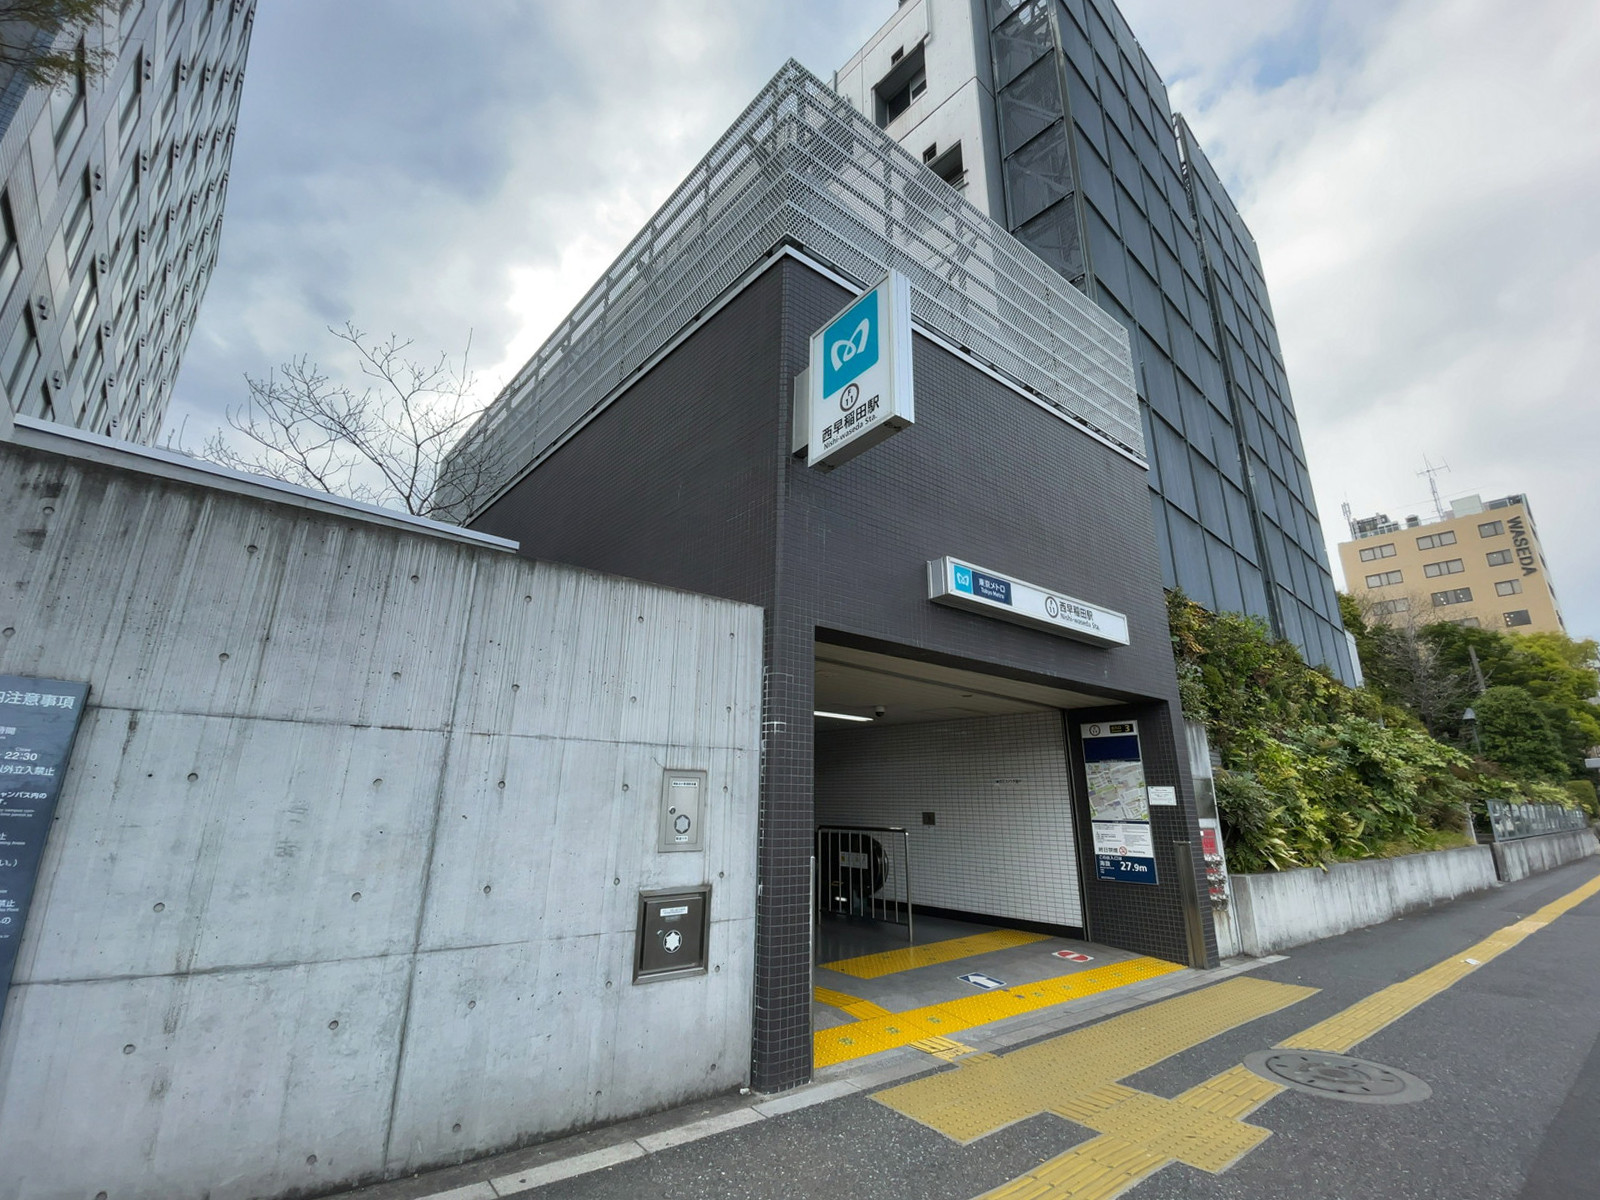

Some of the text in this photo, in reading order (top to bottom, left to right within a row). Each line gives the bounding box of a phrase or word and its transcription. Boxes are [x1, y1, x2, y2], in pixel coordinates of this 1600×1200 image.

[845, 395, 854, 406] 11
[822, 394, 880, 443] 西早稲田駅
[823, 414, 877, 450] Nishi-waseda Sta.
[1507, 515, 1537, 577] WASEDA
[1059, 600, 1094, 621] 西早稲田駅
[1124, 724, 1131, 732] 3
[4, 751, 38, 761] 22:30
[1120, 861, 1148, 872] 27.9m
